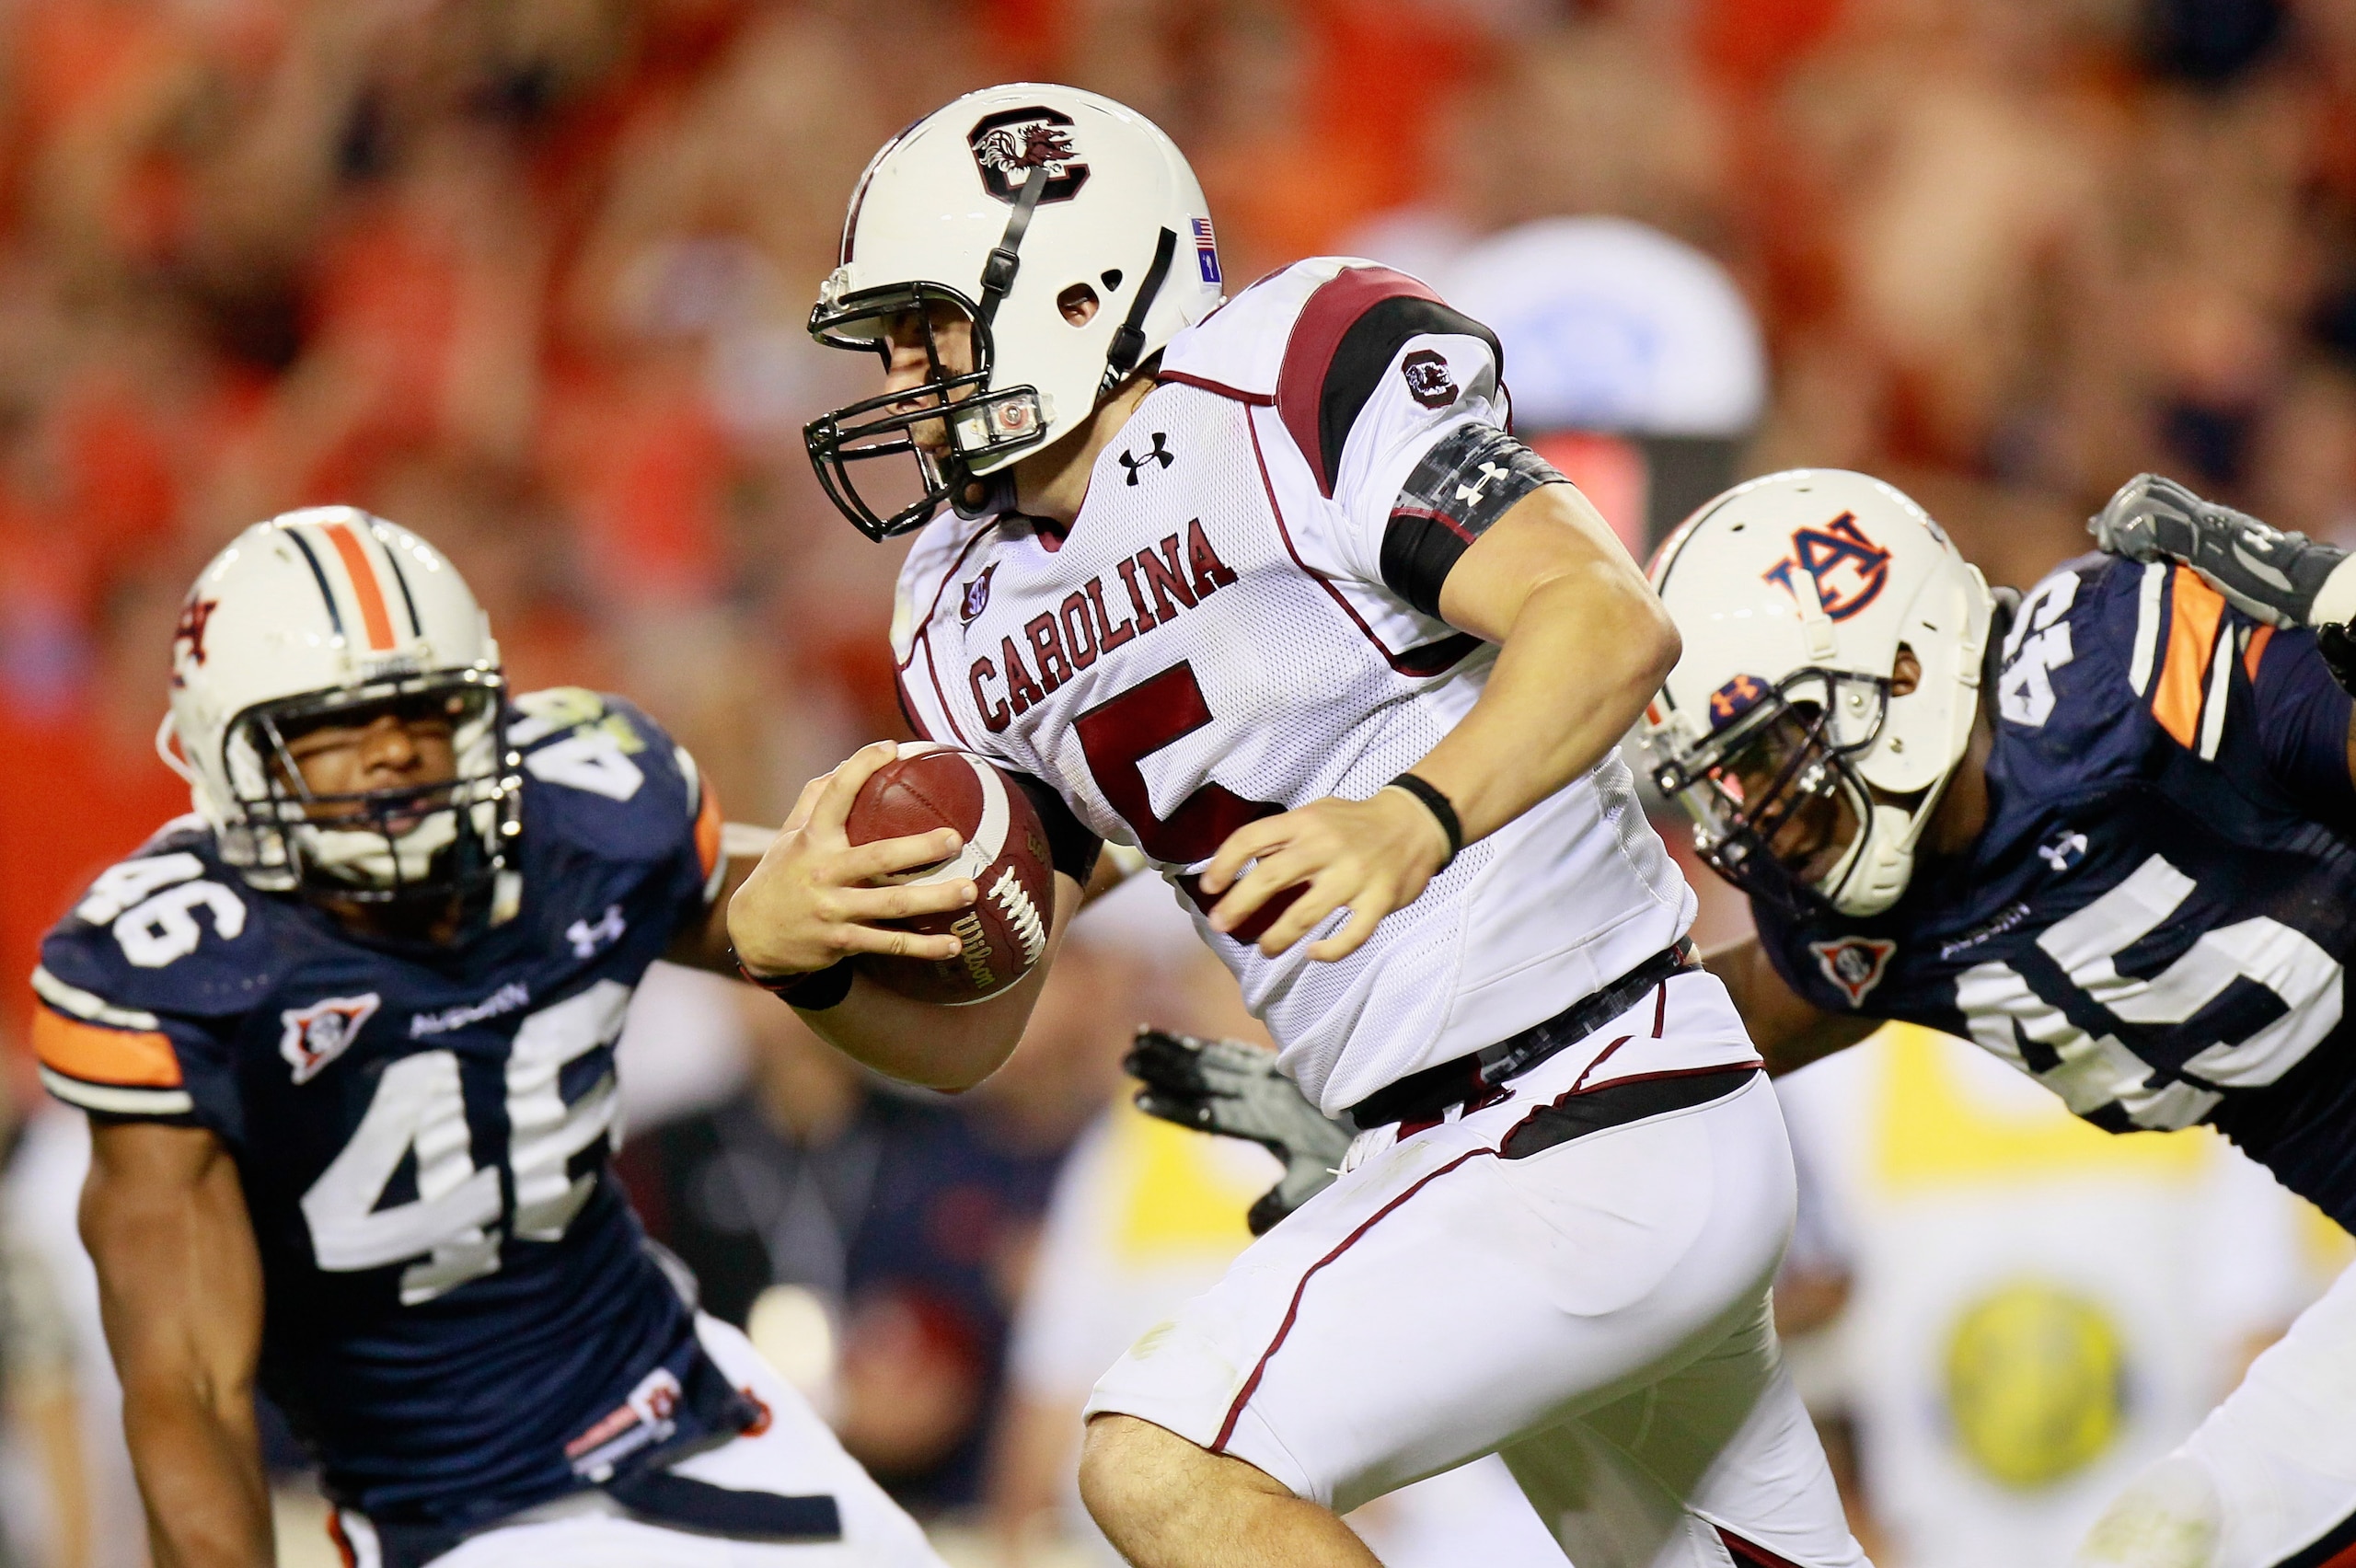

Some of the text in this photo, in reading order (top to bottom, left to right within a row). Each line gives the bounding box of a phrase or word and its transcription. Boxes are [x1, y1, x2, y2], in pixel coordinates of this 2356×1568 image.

[969, 516, 1240, 733] CAROLINA
[1998, 570, 2082, 728] 45
[77, 852, 247, 968] 46
[1071, 658, 1314, 945] 5
[950, 911, 997, 989] Wilson
[1955, 852, 2344, 1132] 45
[300, 989, 632, 1307] 46
